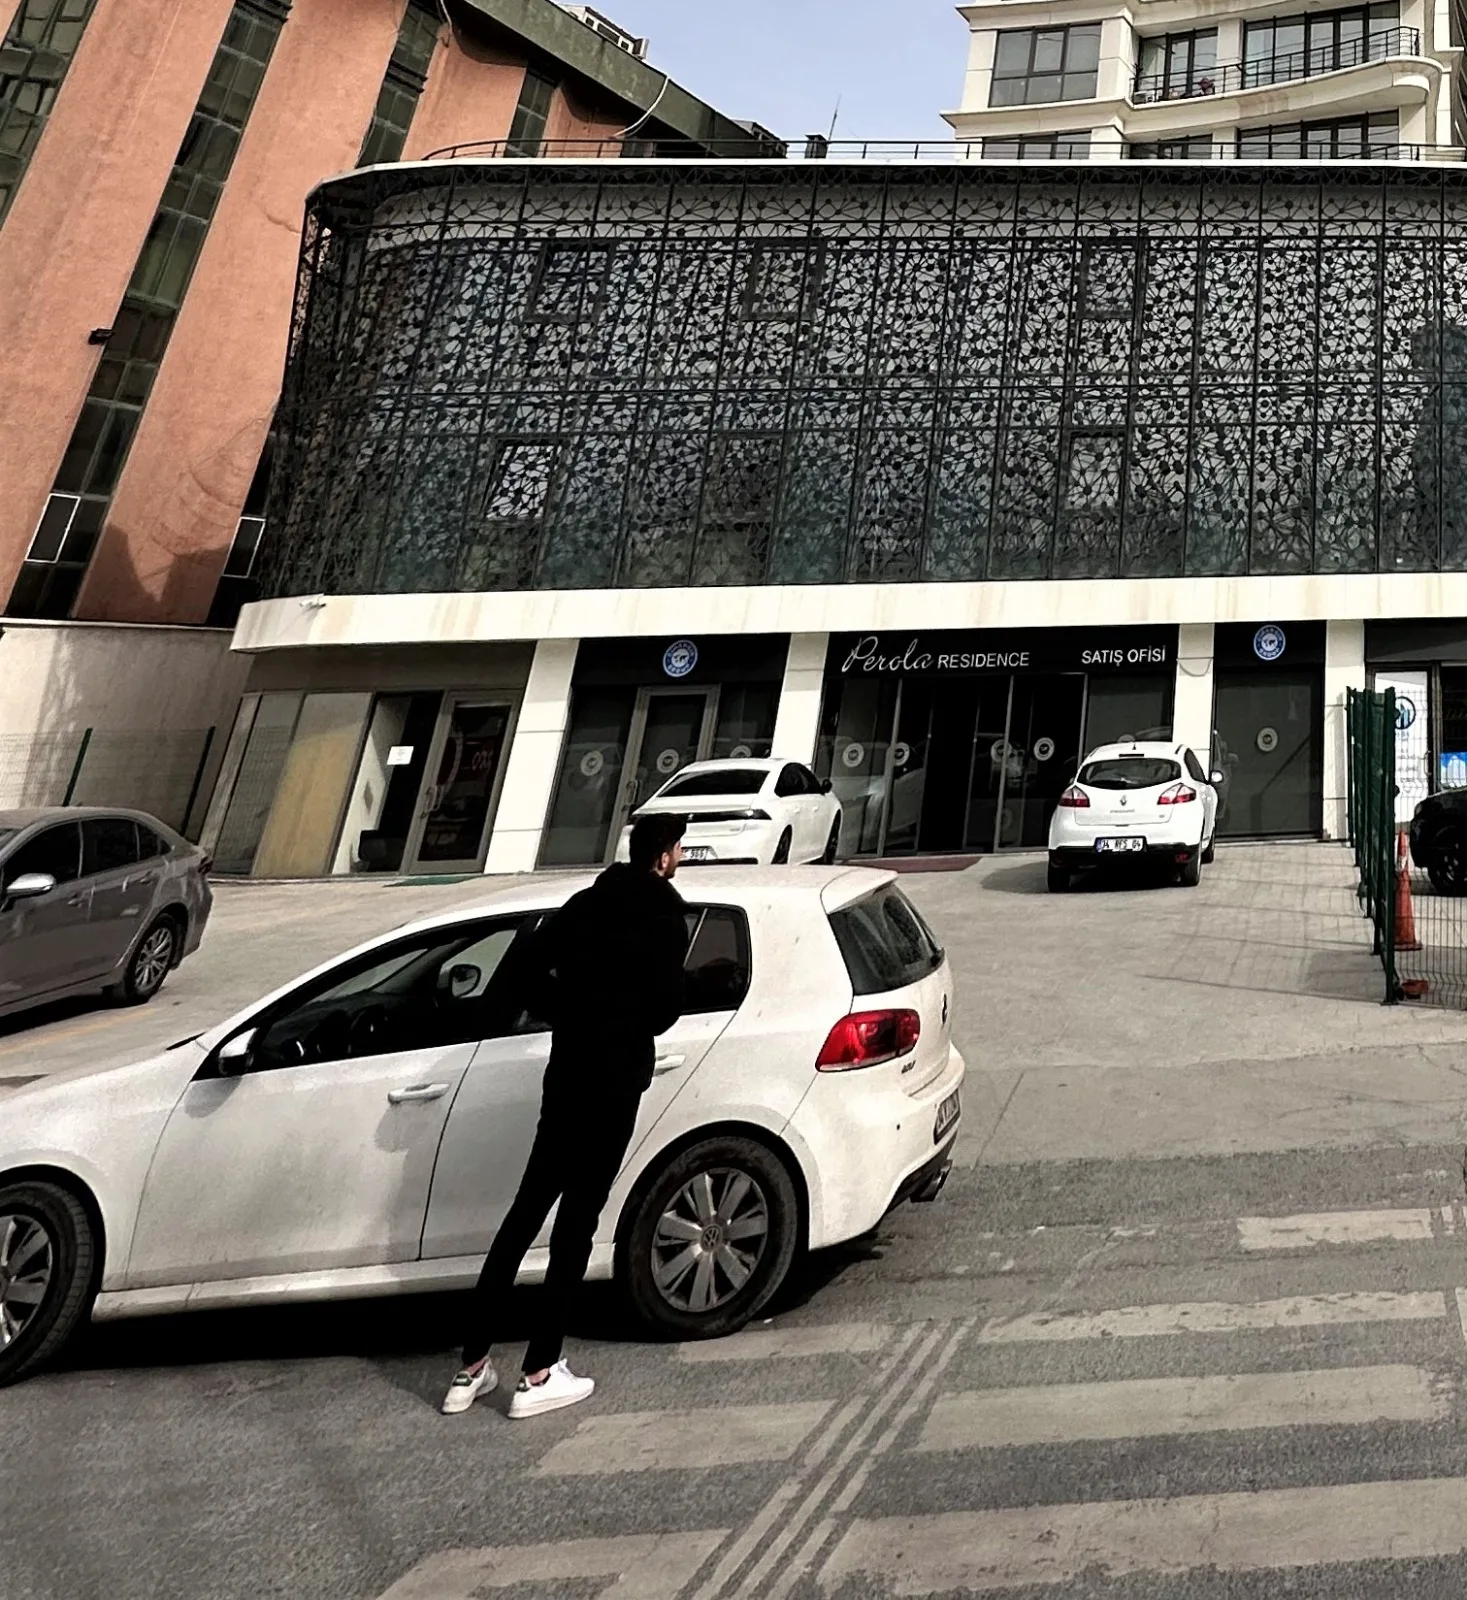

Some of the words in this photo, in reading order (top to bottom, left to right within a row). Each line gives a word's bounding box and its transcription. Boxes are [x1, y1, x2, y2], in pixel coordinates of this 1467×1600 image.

[841, 636, 935, 672] Perola
[937, 651, 1030, 668] RESIDENCE
[1081, 650, 1124, 666] SATIŞ
[1126, 645, 1166, 663] OFİSİ
